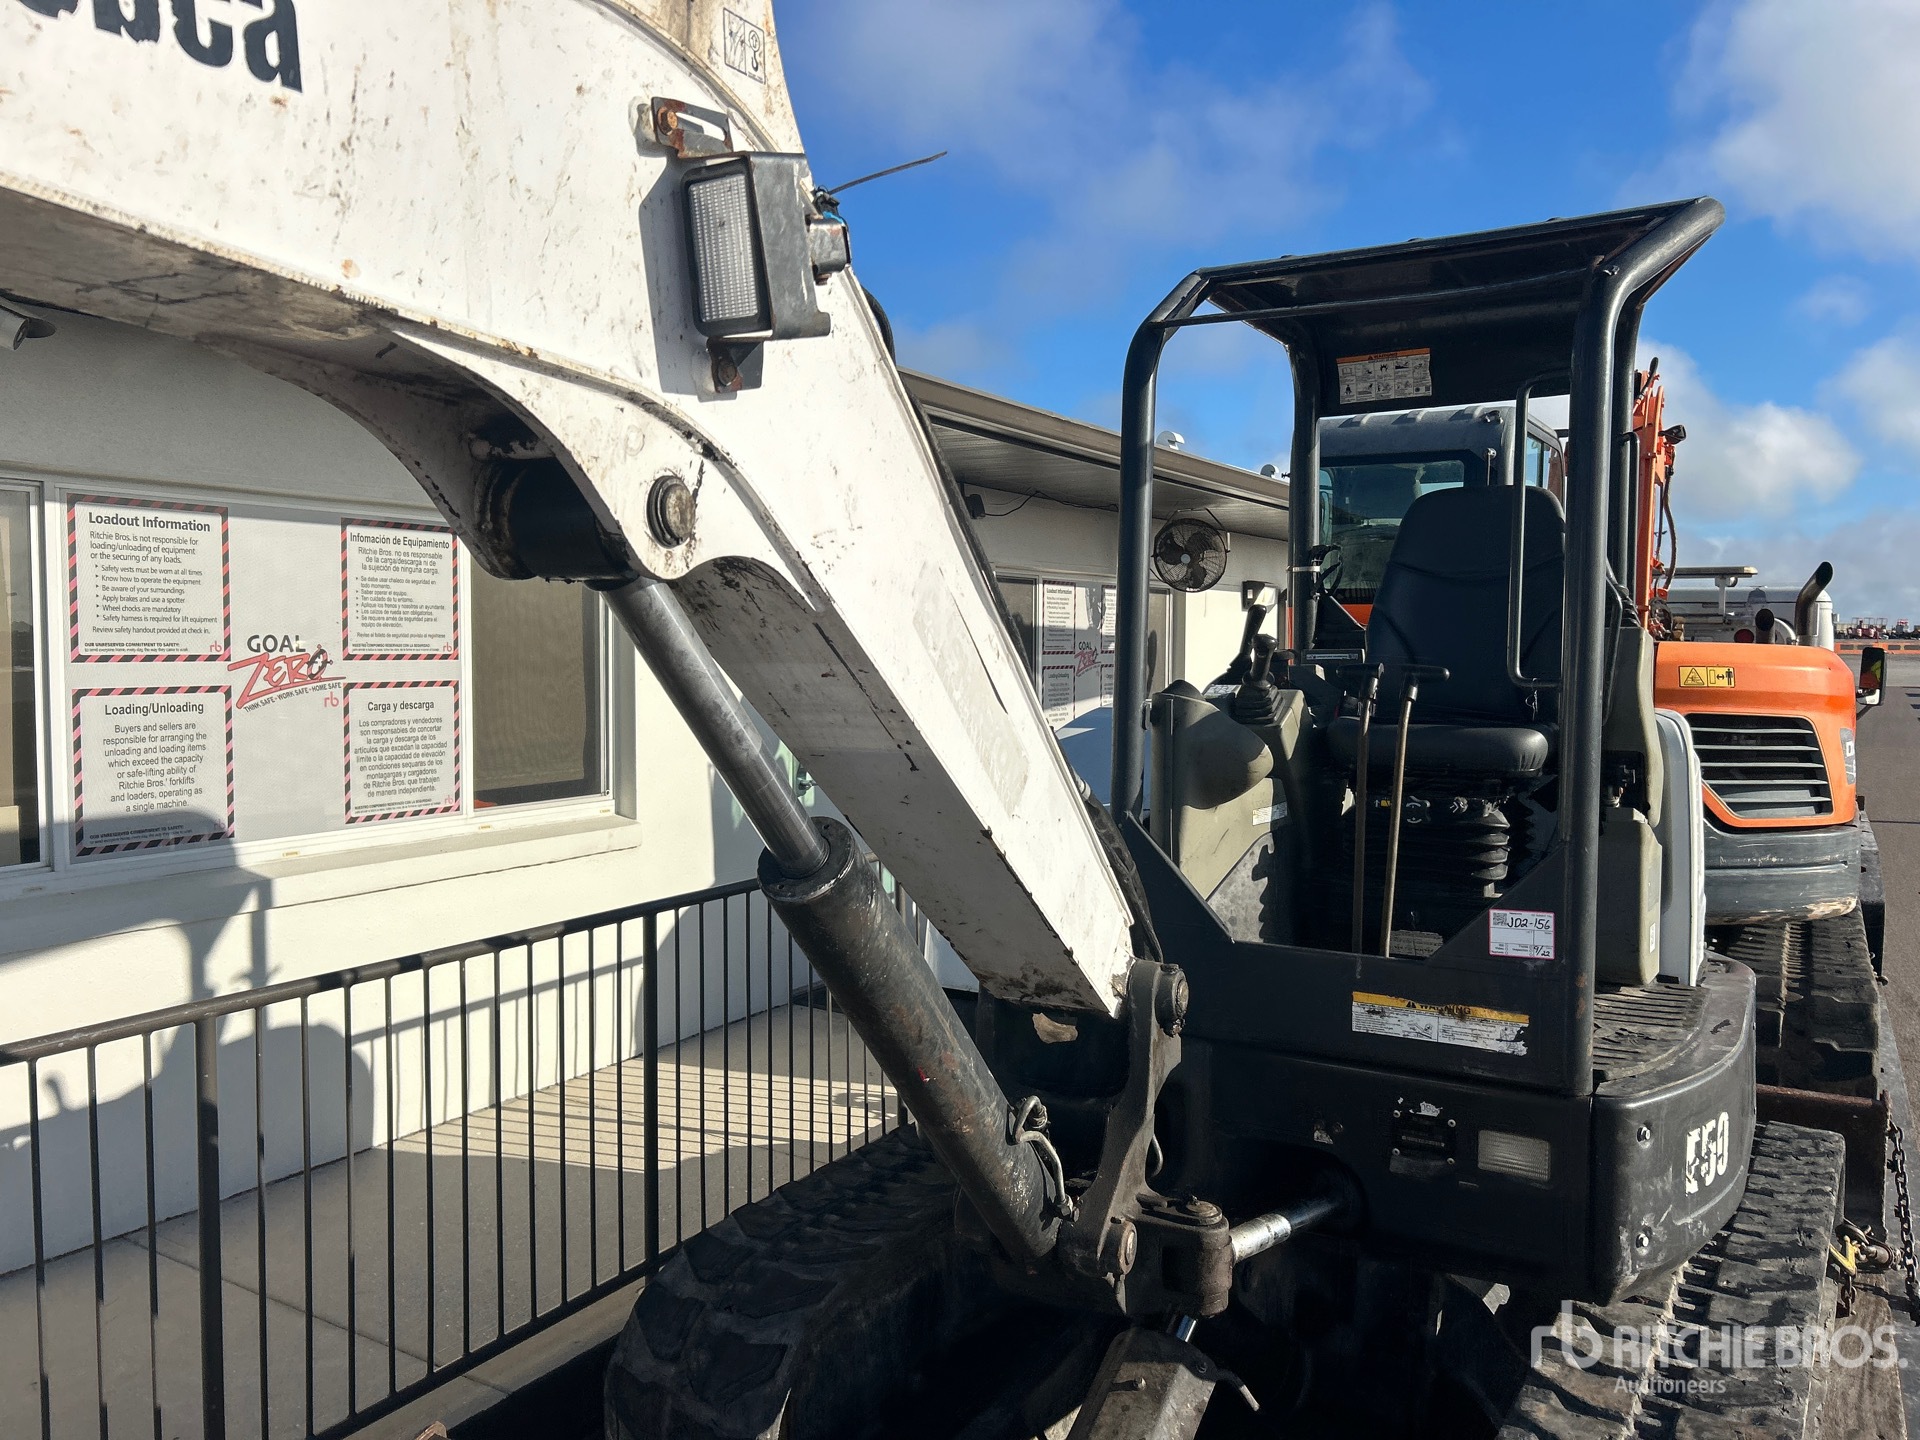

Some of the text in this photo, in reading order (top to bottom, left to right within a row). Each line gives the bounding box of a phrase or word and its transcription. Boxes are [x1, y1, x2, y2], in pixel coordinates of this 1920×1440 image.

[89, 512, 210, 532] Loadout Information
[90, 531, 113, 540] Ritchie
[133, 534, 138, 542] is
[152, 536, 188, 545] responsible
[392, 536, 401, 545] de
[403, 537, 450, 549] Equipamiento
[90, 541, 152, 554] loading/unloading
[162, 546, 196, 555] equipment
[358, 547, 378, 555] Ritchie
[411, 551, 442, 559] responsable
[100, 552, 110, 560] the
[112, 554, 140, 563] securing
[150, 556, 162, 564] any
[102, 564, 119, 573] Safety
[102, 595, 118, 603] Apply
[152, 606, 181, 614] mandatory
[150, 616, 172, 624] required
[115, 626, 131, 634] safety
[247, 634, 306, 652] GOAL
[227, 644, 340, 709] ZERO
[243, 702, 261, 712] THINK
[261, 696, 275, 706] SAFE
[277, 690, 295, 700] WORK
[296, 686, 309, 696] SAFE
[312, 683, 327, 692] HOME
[324, 691, 339, 707] rb
[105, 702, 204, 716] Loading/Unloading
[368, 701, 434, 712] Carga y descarga
[115, 725, 141, 734] Buyers
[143, 723, 157, 731] and
[159, 722, 182, 731] sellers
[371, 718, 406, 727] compradores
[103, 732, 207, 746] responsible for arranging the
[373, 737, 388, 745] carga
[105, 747, 141, 757] unloading
[144, 746, 157, 754] and
[160, 744, 185, 753] loading
[108, 754, 203, 767] which exceed the capacity
[127, 768, 164, 778] safe-lifting
[167, 766, 187, 775] ability
[189, 765, 196, 773] of
[119, 776, 195, 789] Ritchie forklifts
[111, 794, 125, 802] and
[159, 788, 192, 798] operating
[132, 802, 154, 812] single
[1507, 917, 1550, 930] JD2-156
